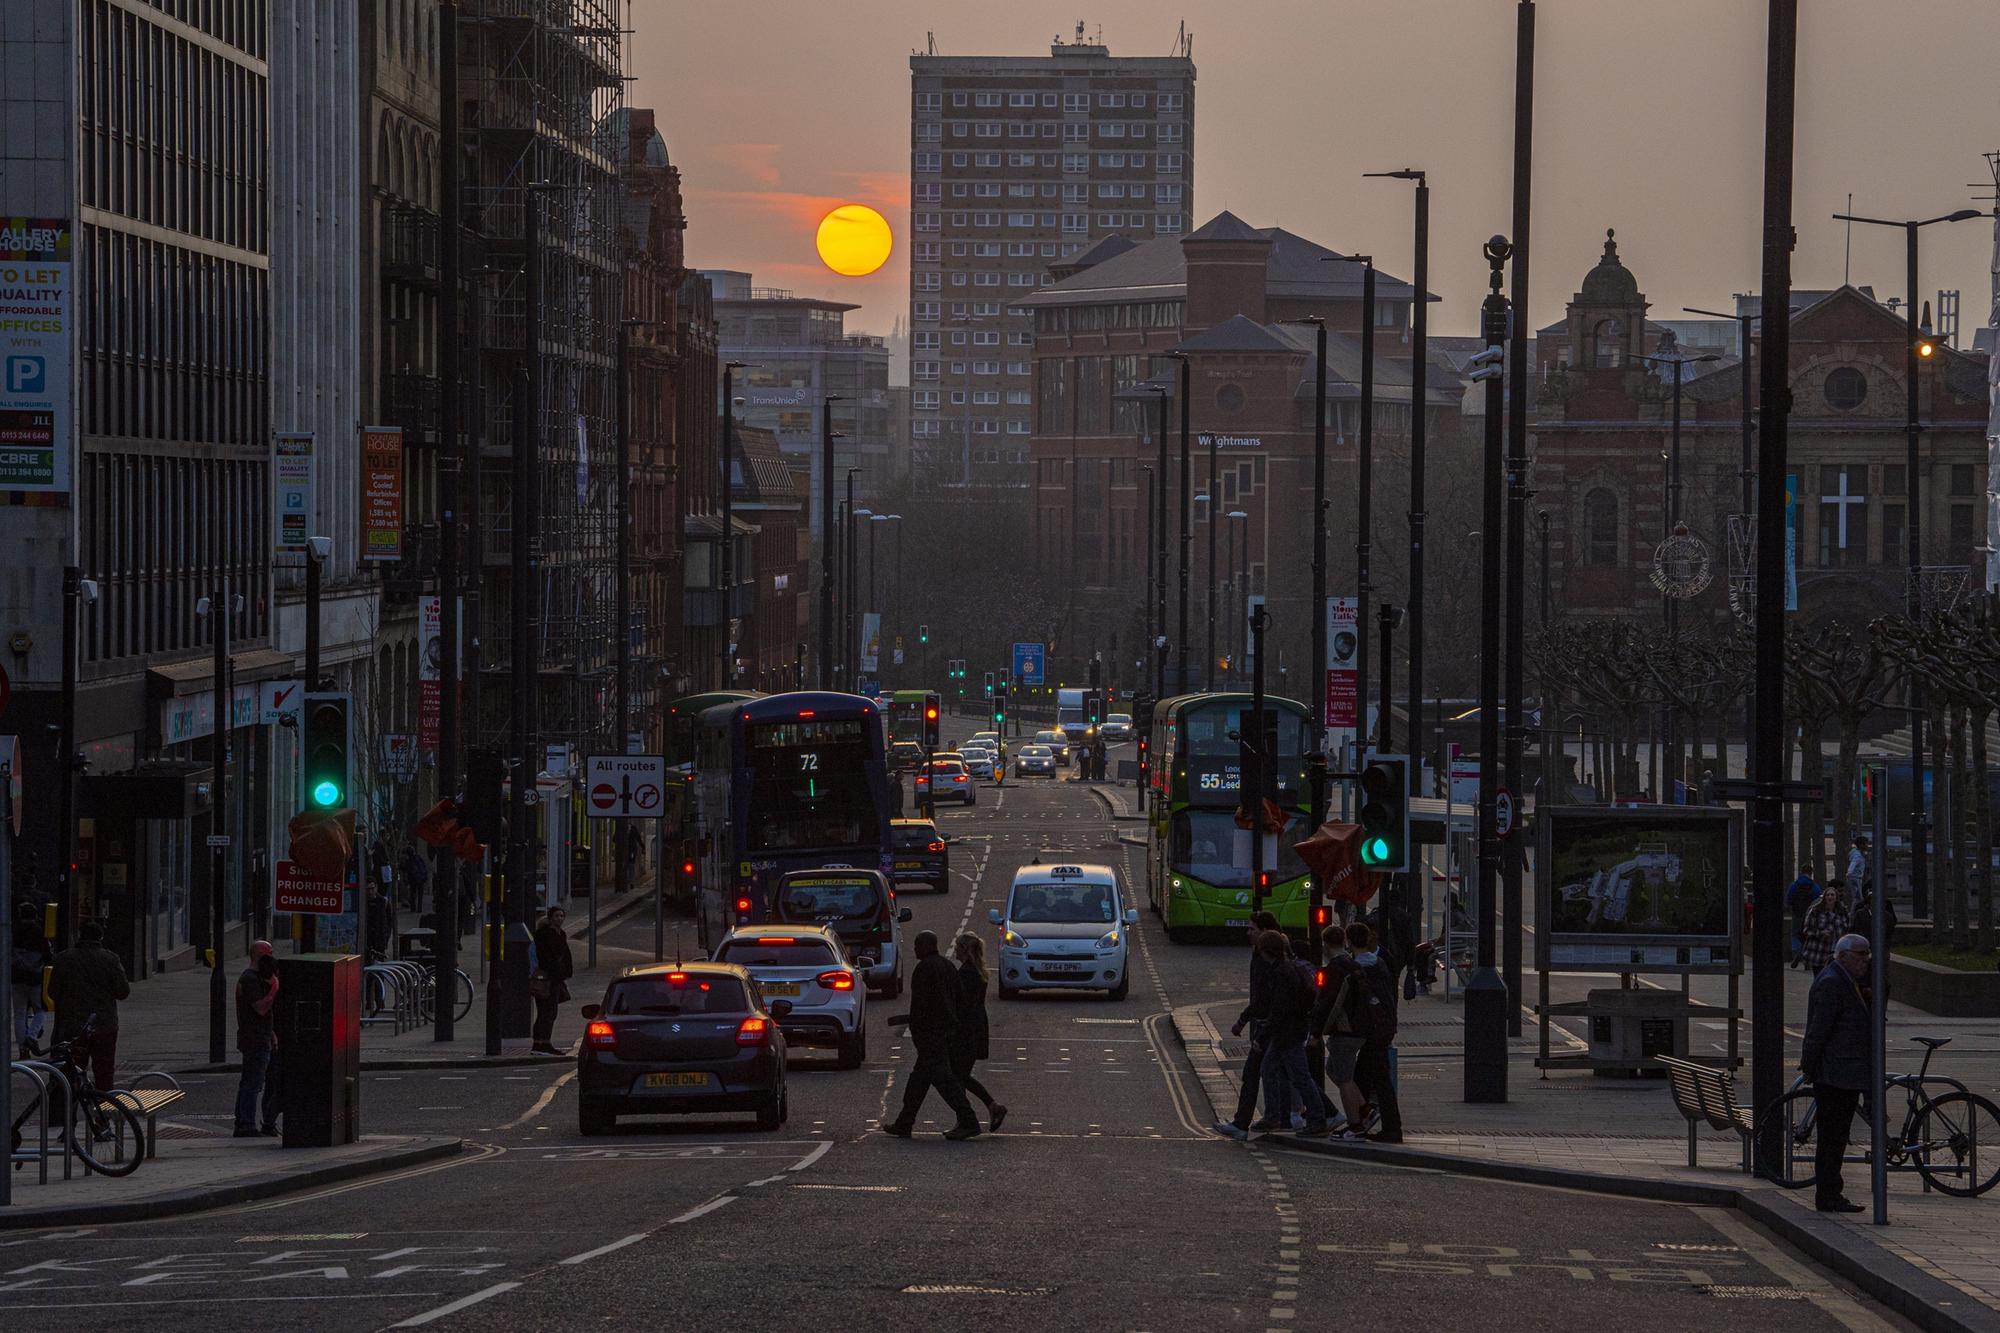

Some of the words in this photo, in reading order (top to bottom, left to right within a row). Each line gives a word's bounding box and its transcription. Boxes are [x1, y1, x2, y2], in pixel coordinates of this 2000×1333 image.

[0, 228, 64, 241] ALLERY
[0, 269, 19, 283] O
[25, 270, 61, 284] LET
[0, 289, 62, 301] UALITY
[0, 306, 62, 316] FFORDABLE
[0, 320, 62, 332] FFICES
[11, 338, 41, 347] WITH
[13, 359, 41, 389] P
[752, 395, 799, 405] TransUnion
[367, 441, 400, 450] HOUSE
[0, 453, 39, 464] CBRE
[597, 761, 613, 770] All
[617, 761, 656, 771] routes
[800, 753, 818, 770] 72
[1201, 773, 1220, 789] 55
[524, 794, 537, 802] 20
[1054, 866, 1081, 874] TAXI
[277, 879, 342, 893] PRIORITIES
[280, 895, 338, 907] CHANGED
[649, 1072, 679, 1084] KV68
[0, 1262, 507, 1292] LEAR
